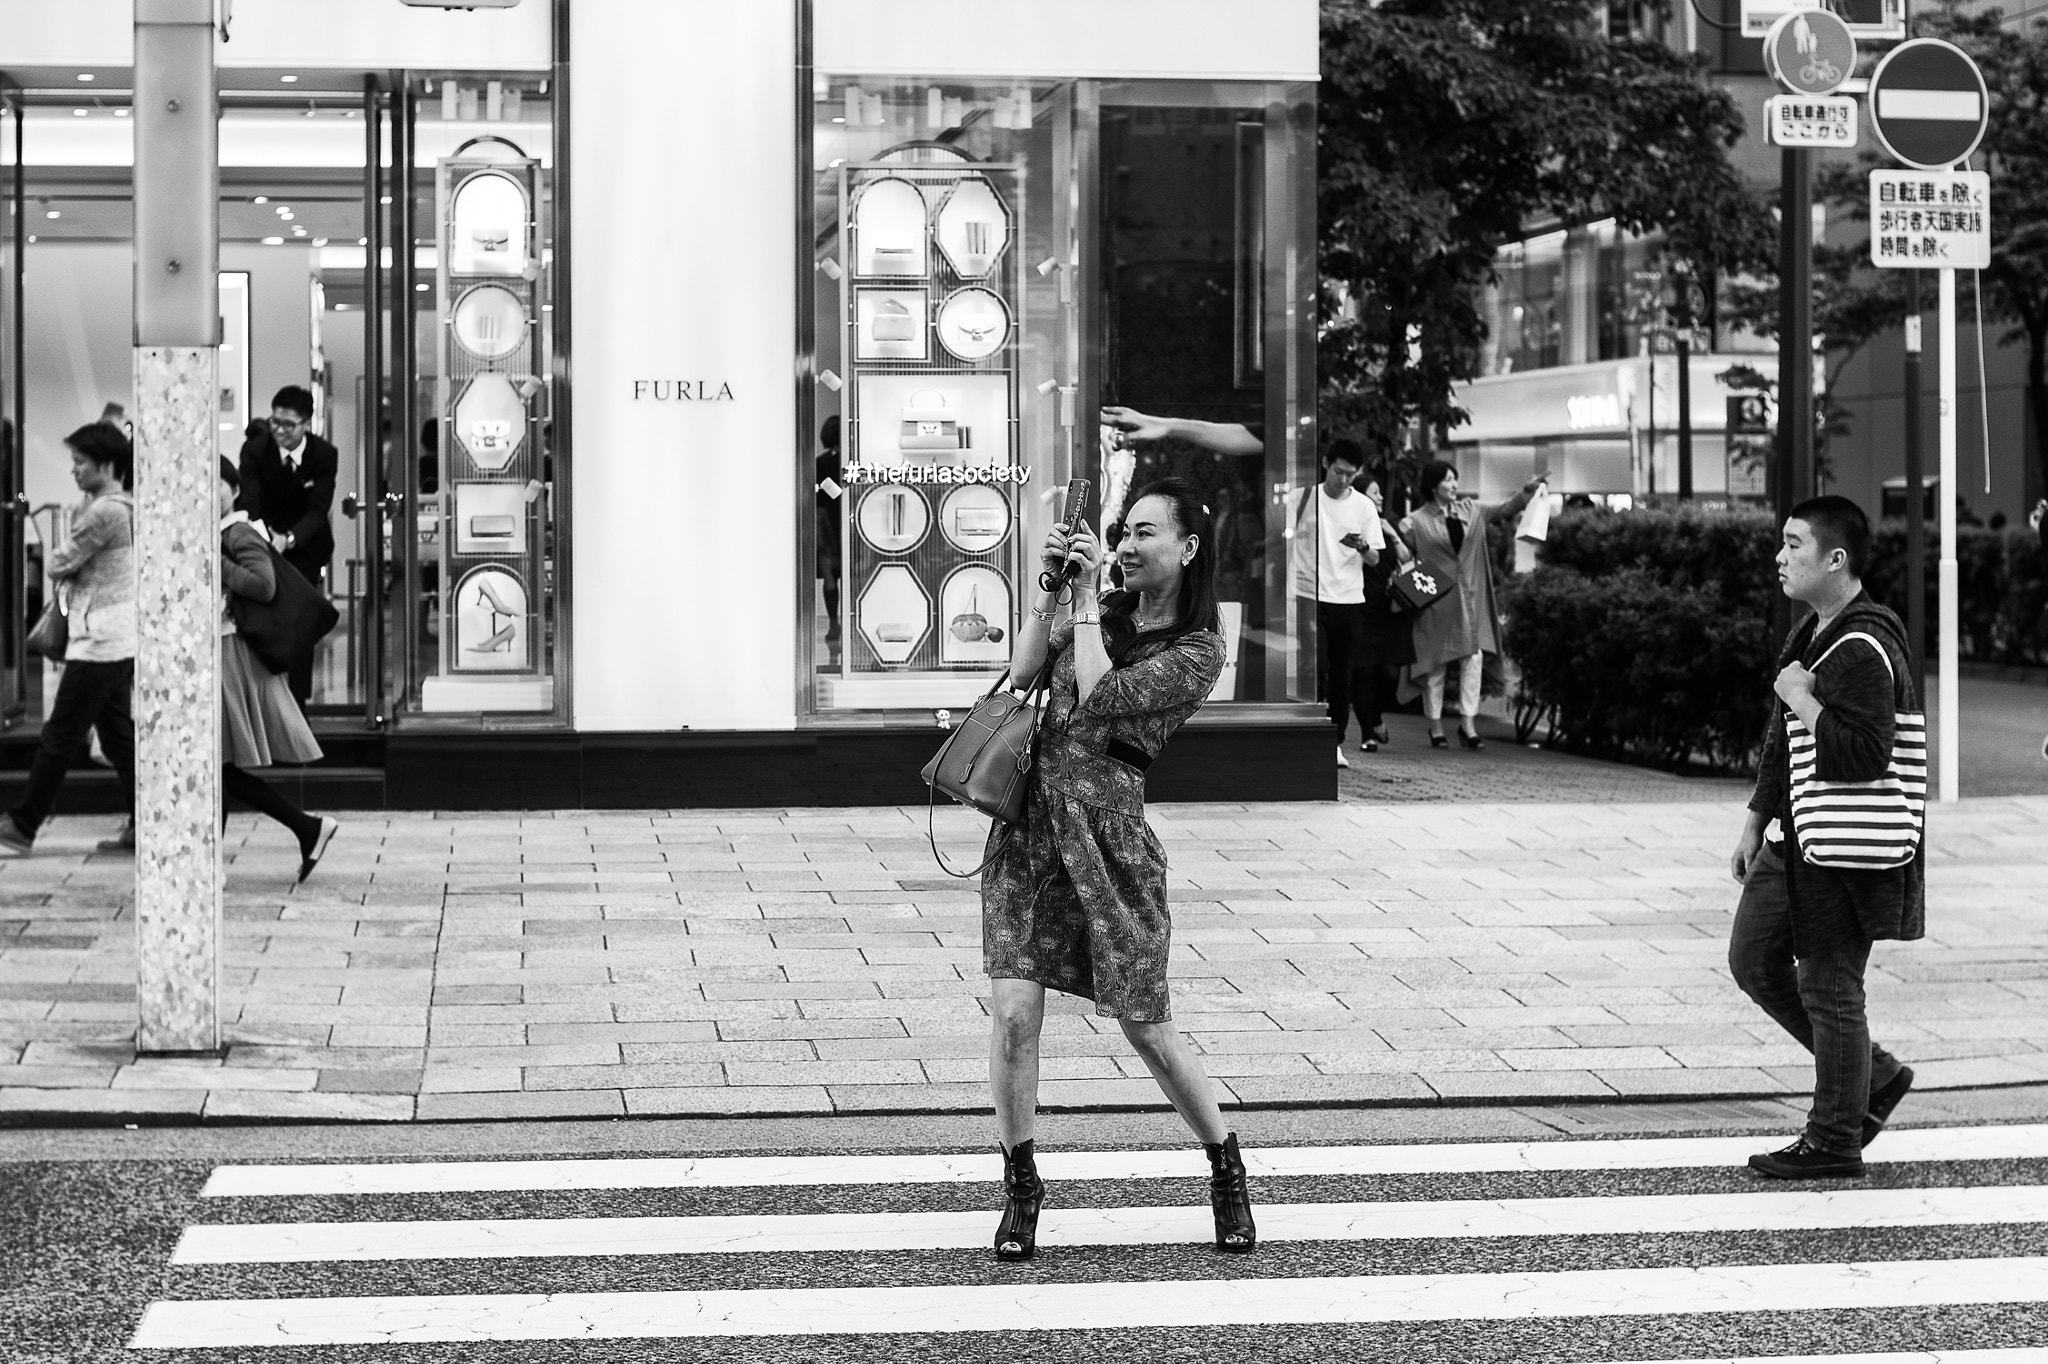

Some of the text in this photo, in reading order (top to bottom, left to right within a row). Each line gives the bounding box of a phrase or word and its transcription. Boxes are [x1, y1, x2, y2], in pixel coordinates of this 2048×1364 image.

[1783, 122, 1848, 139] ここから
[1880, 182, 1982, 203] 自転車を除く
[1881, 236, 1949, 259] 時間を除く
[633, 380, 735, 401] FURLA
